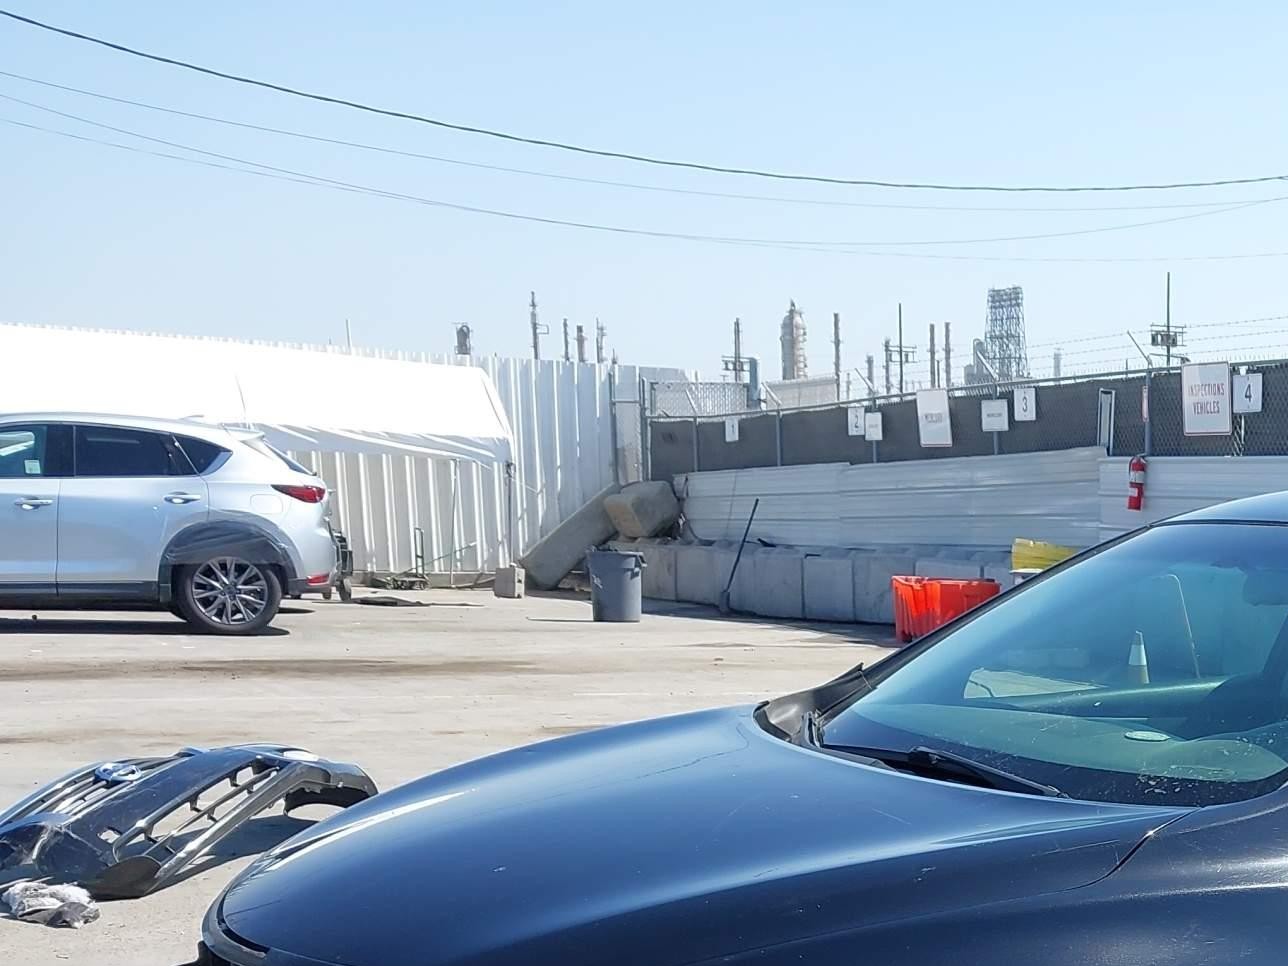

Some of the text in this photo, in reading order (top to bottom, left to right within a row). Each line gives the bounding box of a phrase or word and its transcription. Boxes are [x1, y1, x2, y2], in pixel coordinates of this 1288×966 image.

[1189, 383, 1225, 397] INSPECTIONS
[1244, 384, 1253, 403] 4
[1021, 396, 1029, 413] 3
[1192, 401, 1220, 415] VEHICLES
[854, 414, 860, 429] 2
